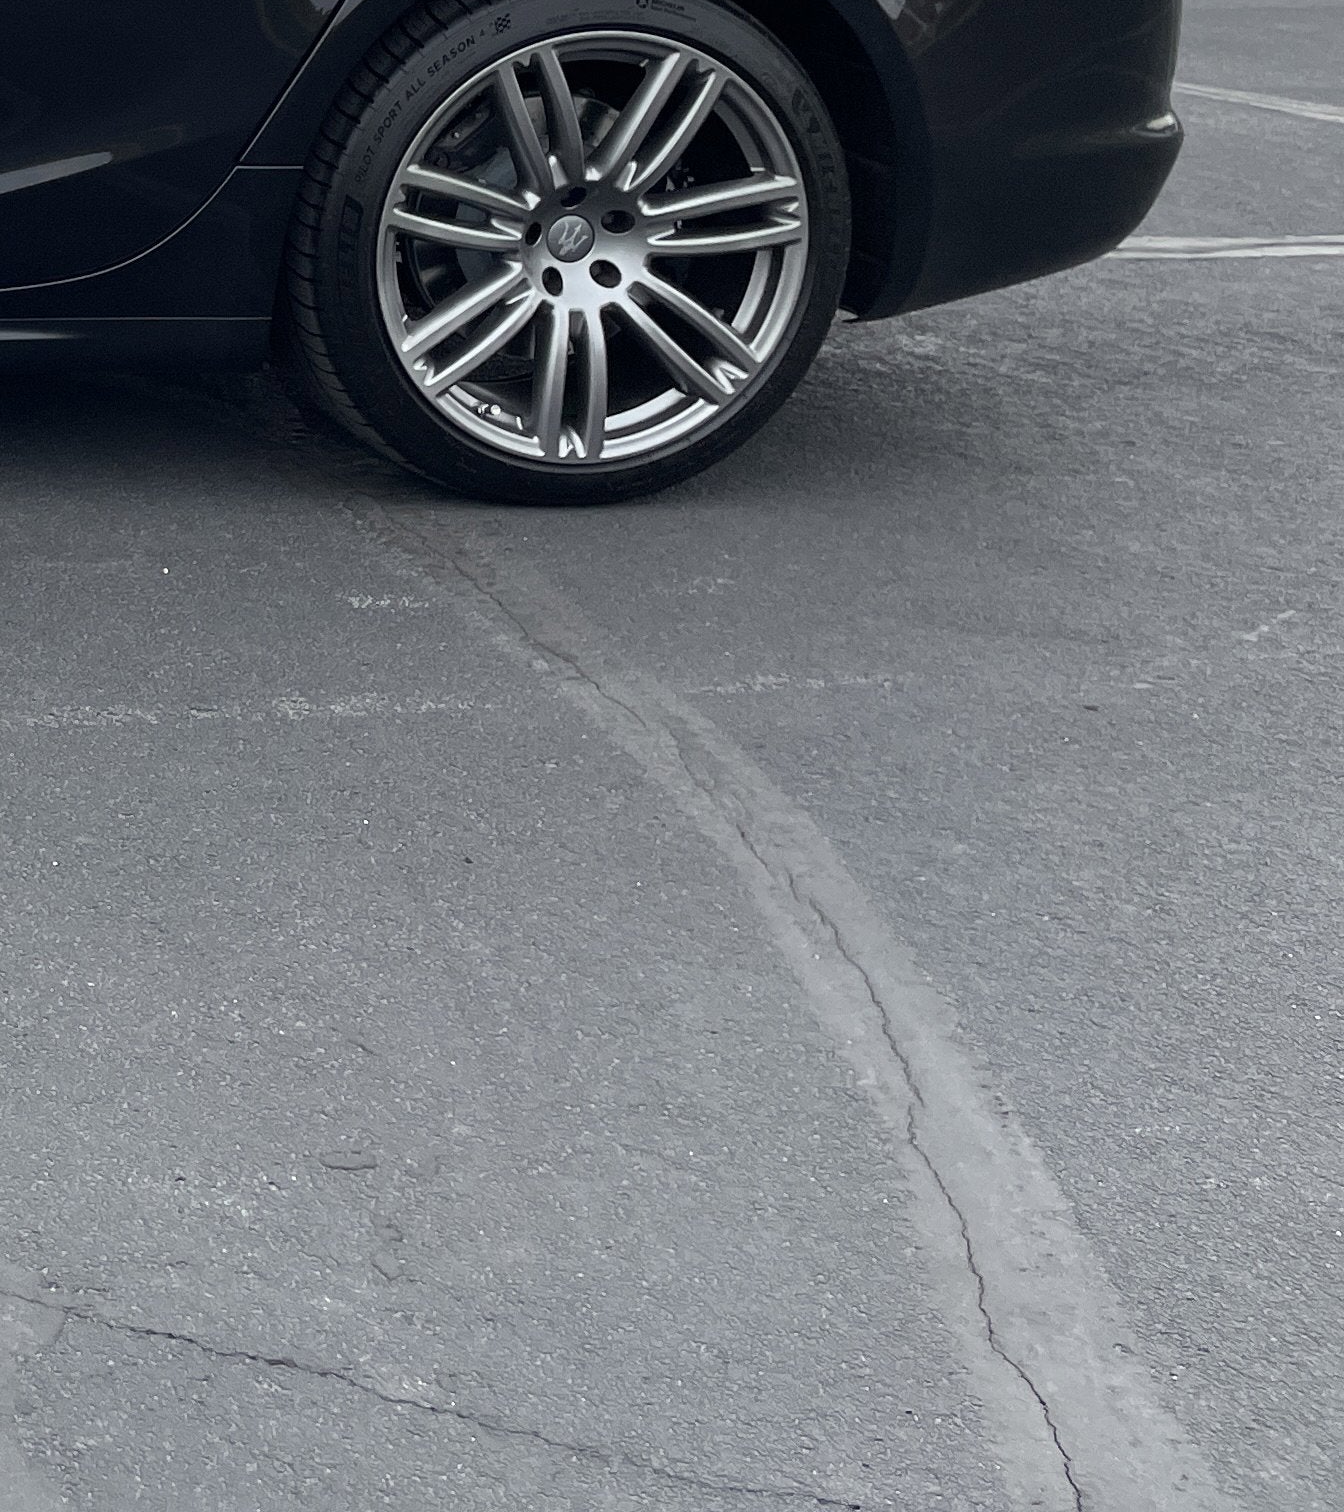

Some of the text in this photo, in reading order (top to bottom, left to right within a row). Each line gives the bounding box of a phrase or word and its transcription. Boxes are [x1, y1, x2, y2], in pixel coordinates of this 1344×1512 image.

[355, 146, 376, 183] PILOT
[374, 100, 403, 142] SPORT
[405, 79, 426, 101] ALL
[427, 35, 477, 77] SEASON
